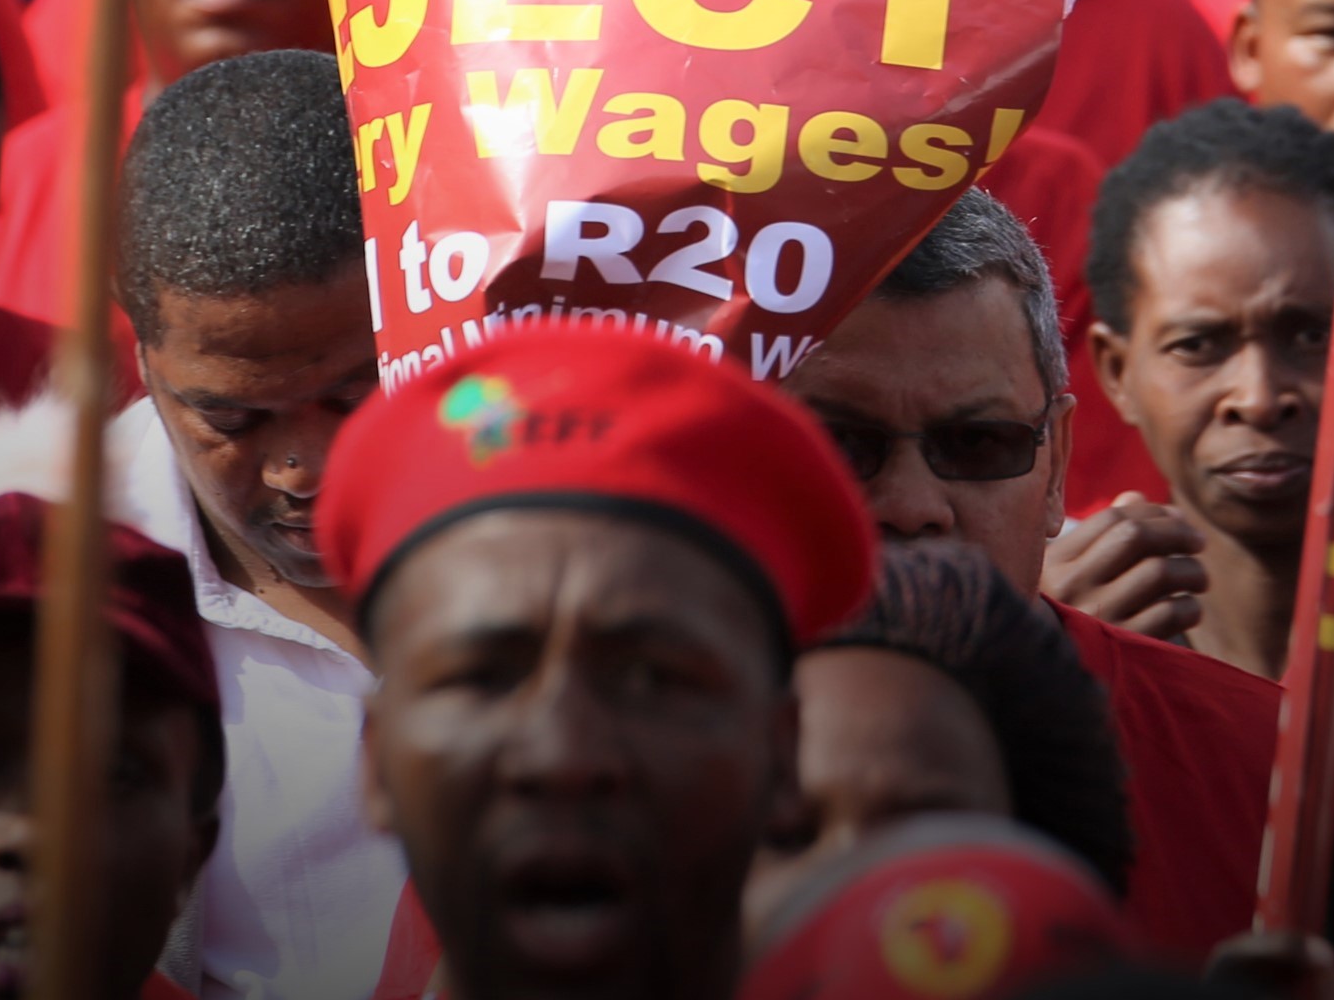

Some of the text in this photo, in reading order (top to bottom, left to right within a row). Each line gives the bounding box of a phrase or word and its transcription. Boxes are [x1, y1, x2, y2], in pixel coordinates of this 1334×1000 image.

[354, 68, 1025, 206] ry Wages!
[399, 219, 490, 314] to
[540, 200, 834, 314] R20
